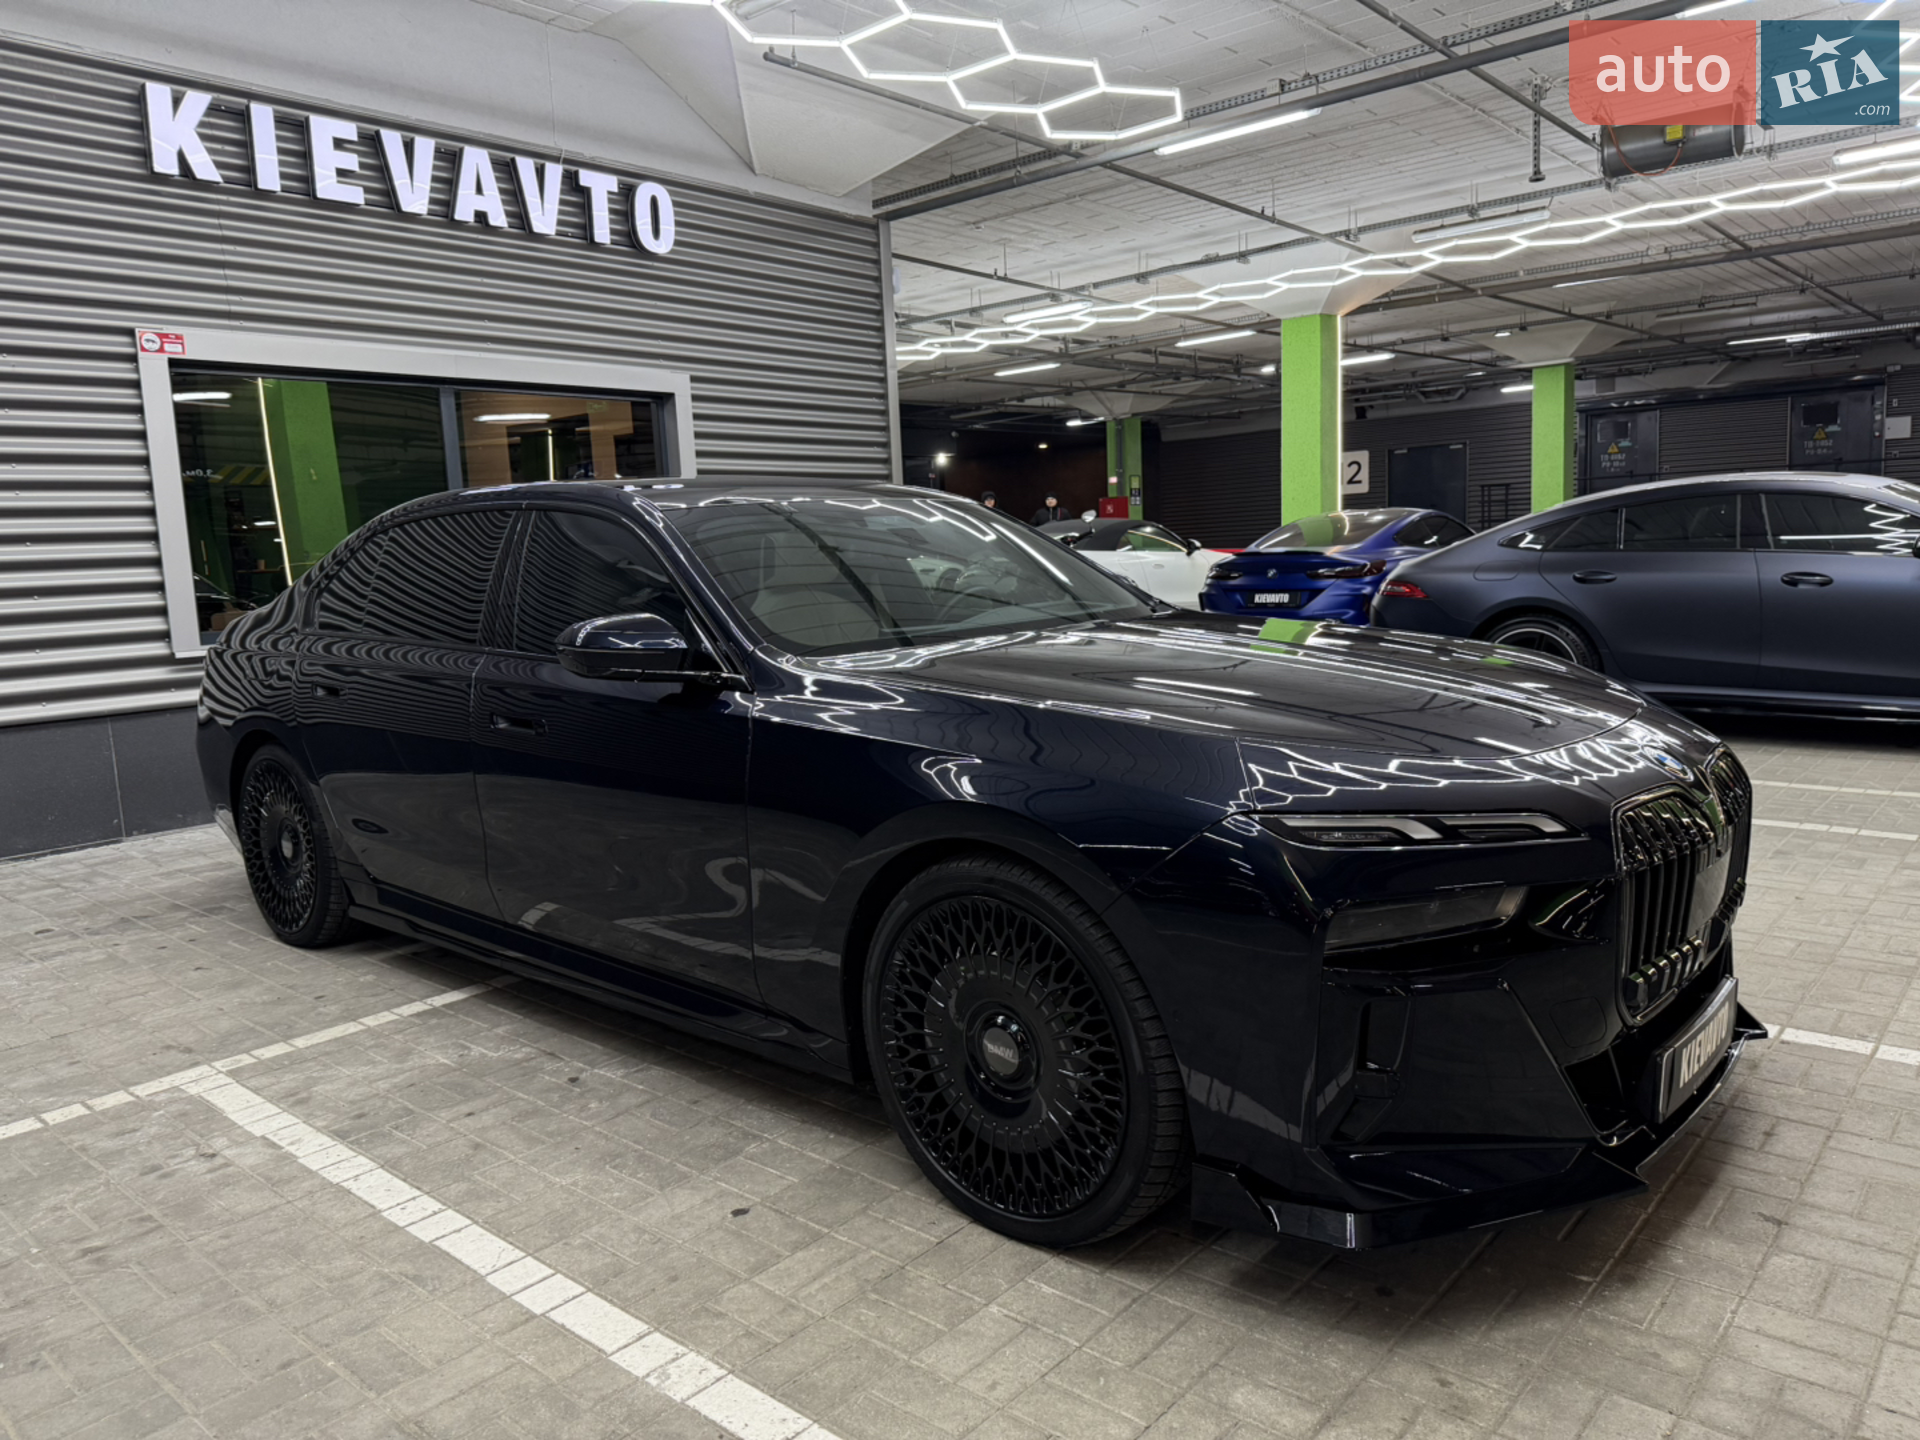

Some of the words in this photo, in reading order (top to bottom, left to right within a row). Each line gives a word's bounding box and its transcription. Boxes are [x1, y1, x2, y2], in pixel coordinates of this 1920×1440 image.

[142, 82, 676, 255] KIEVAVTO
[1254, 592, 1290, 604] KIEVAVTO
[1679, 1000, 1730, 1088] KIEVAVTO
